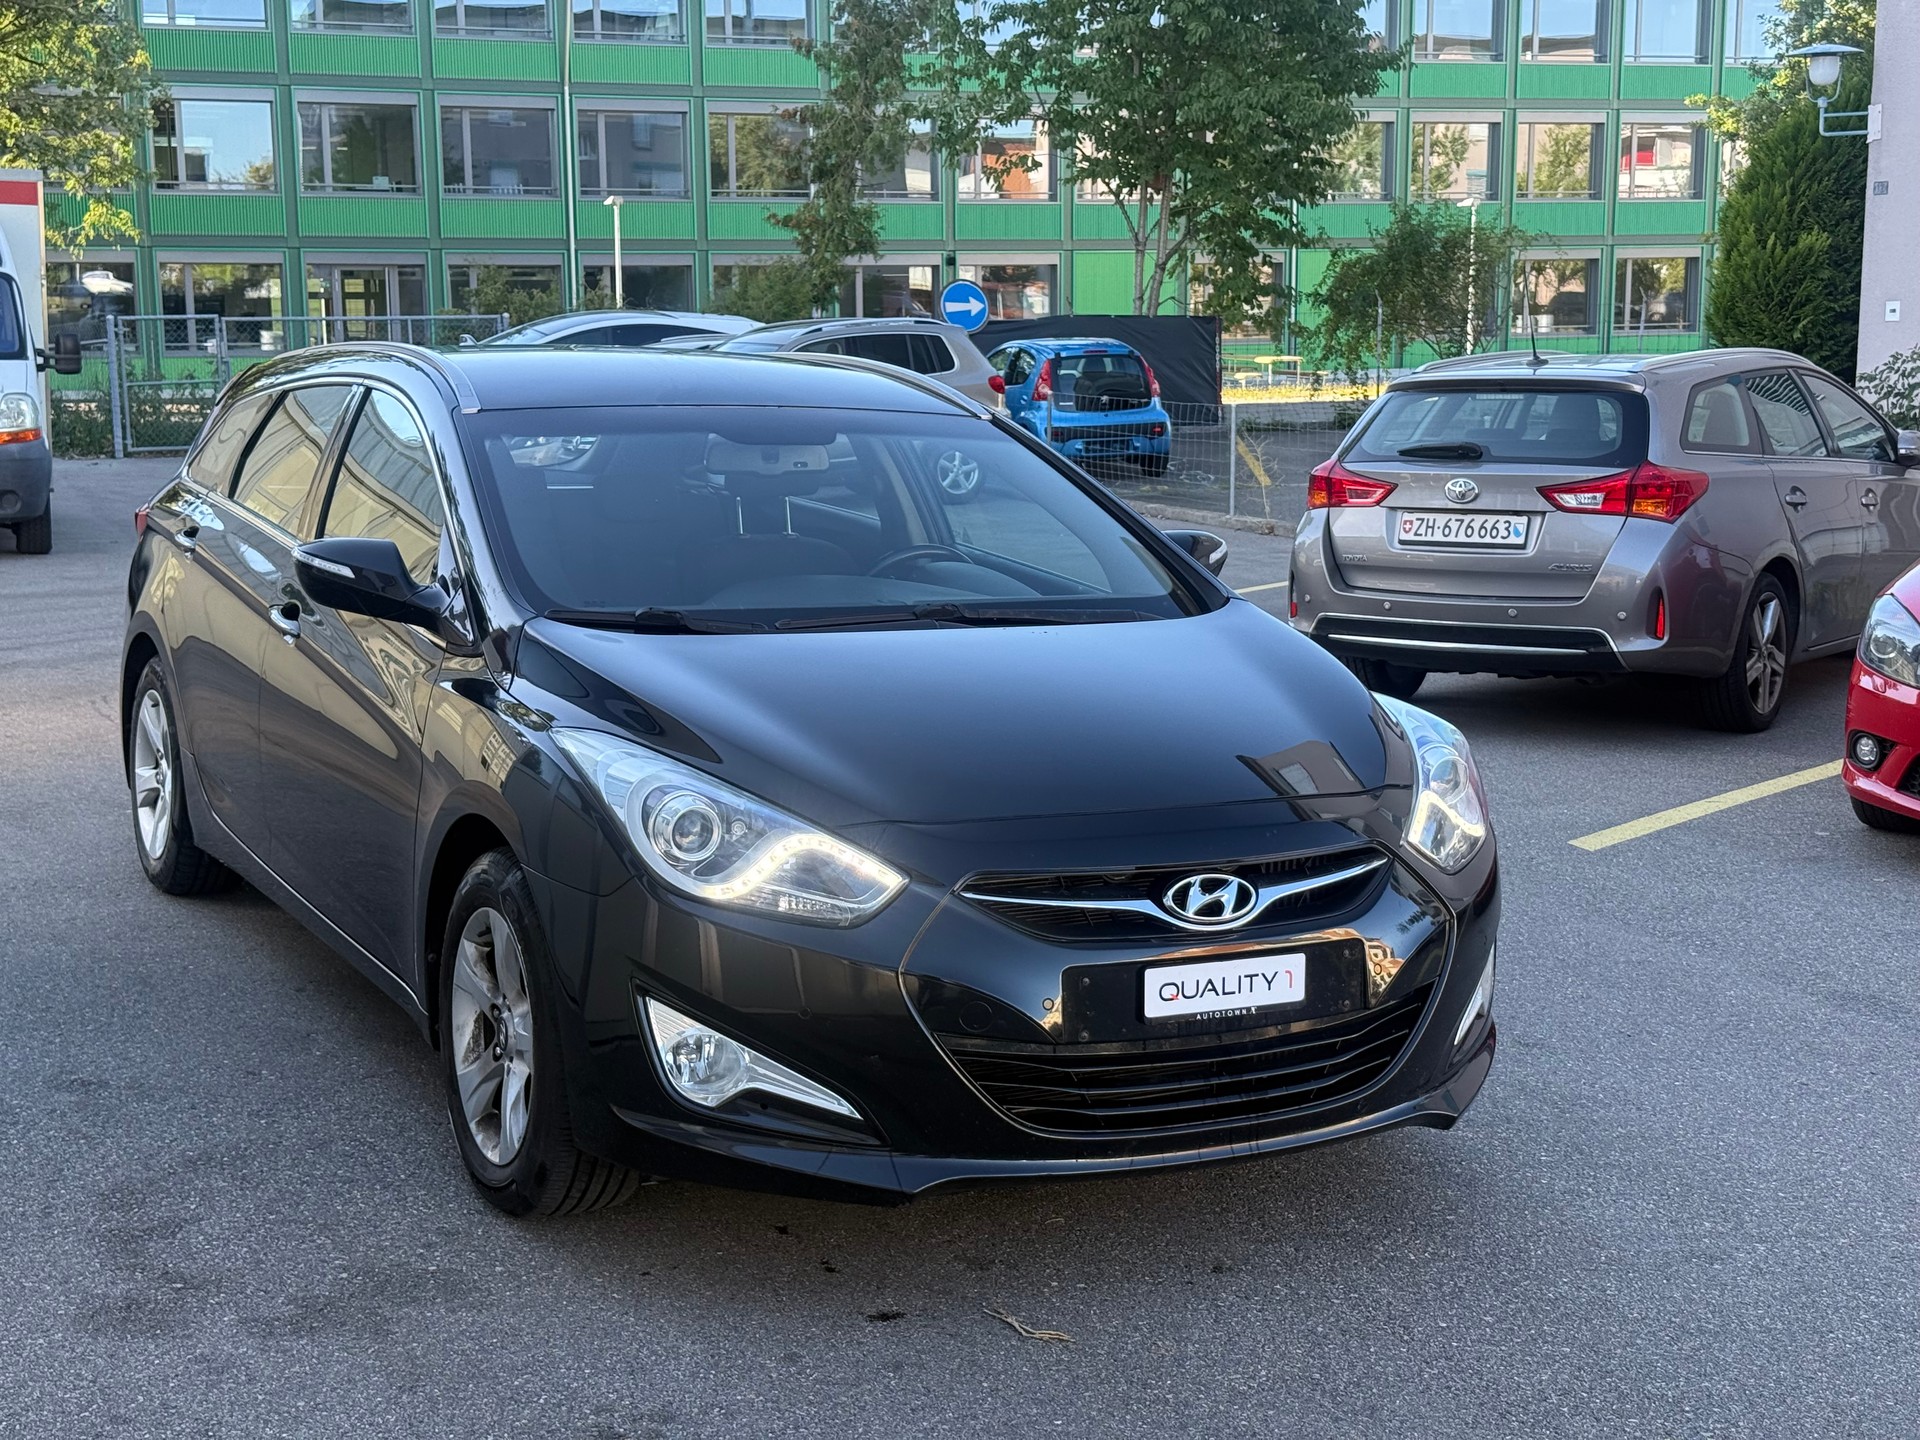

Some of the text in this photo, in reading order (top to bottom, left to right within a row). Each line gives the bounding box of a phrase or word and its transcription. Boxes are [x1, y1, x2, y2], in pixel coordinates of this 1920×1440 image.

[1159, 969, 1294, 1002] QUALITY 1
[1196, 1008, 1247, 1020] AUTOTOWN
